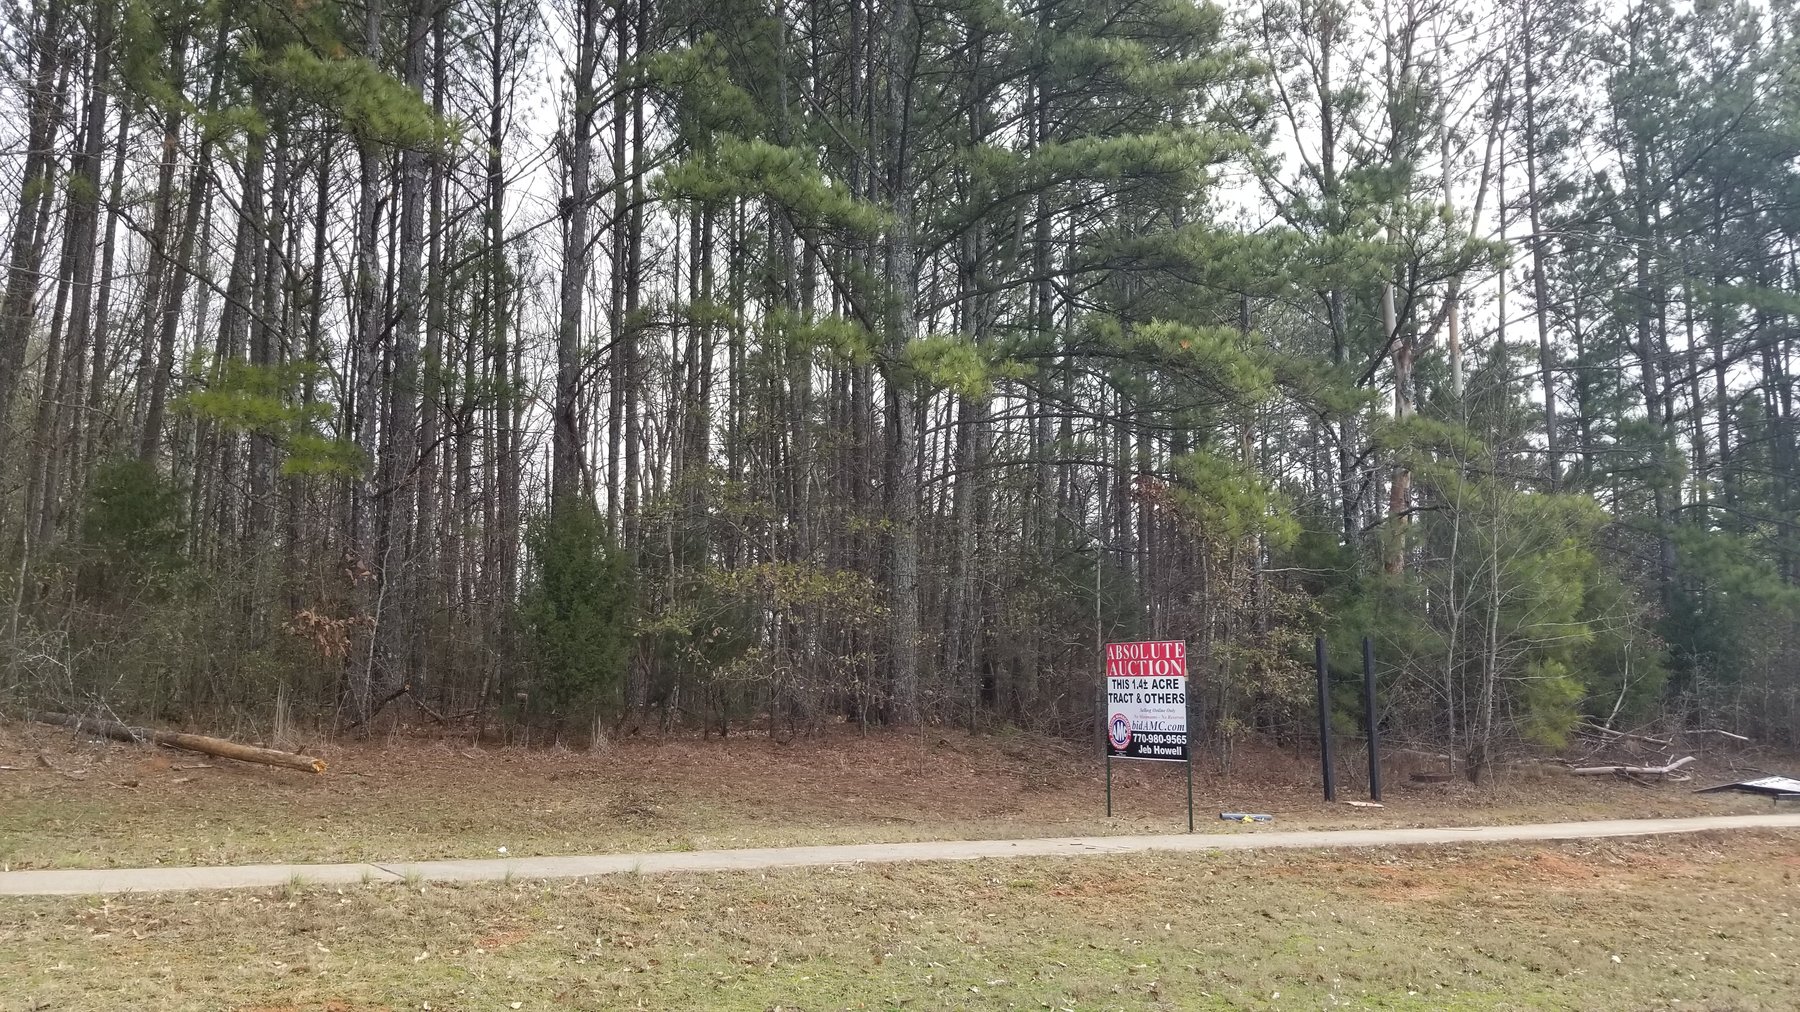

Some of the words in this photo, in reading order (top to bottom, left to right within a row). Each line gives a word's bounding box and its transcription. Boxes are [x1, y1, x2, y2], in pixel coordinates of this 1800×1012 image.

[1107, 642, 1184, 660] ABSOLUTE
[1109, 659, 1183, 676] AUCTION
[1112, 679, 1130, 690] THIS
[1151, 678, 1179, 690] ACRE
[1108, 693, 1133, 703] TRACT
[1136, 693, 1142, 703] &
[1144, 693, 1185, 704] OTHERS
[1131, 720, 1185, 731] bidAMC.com
[1132, 733, 1187, 744] 770-980-9565
[1138, 744, 1152, 754] Jeb
[1153, 745, 1182, 756] Howell
